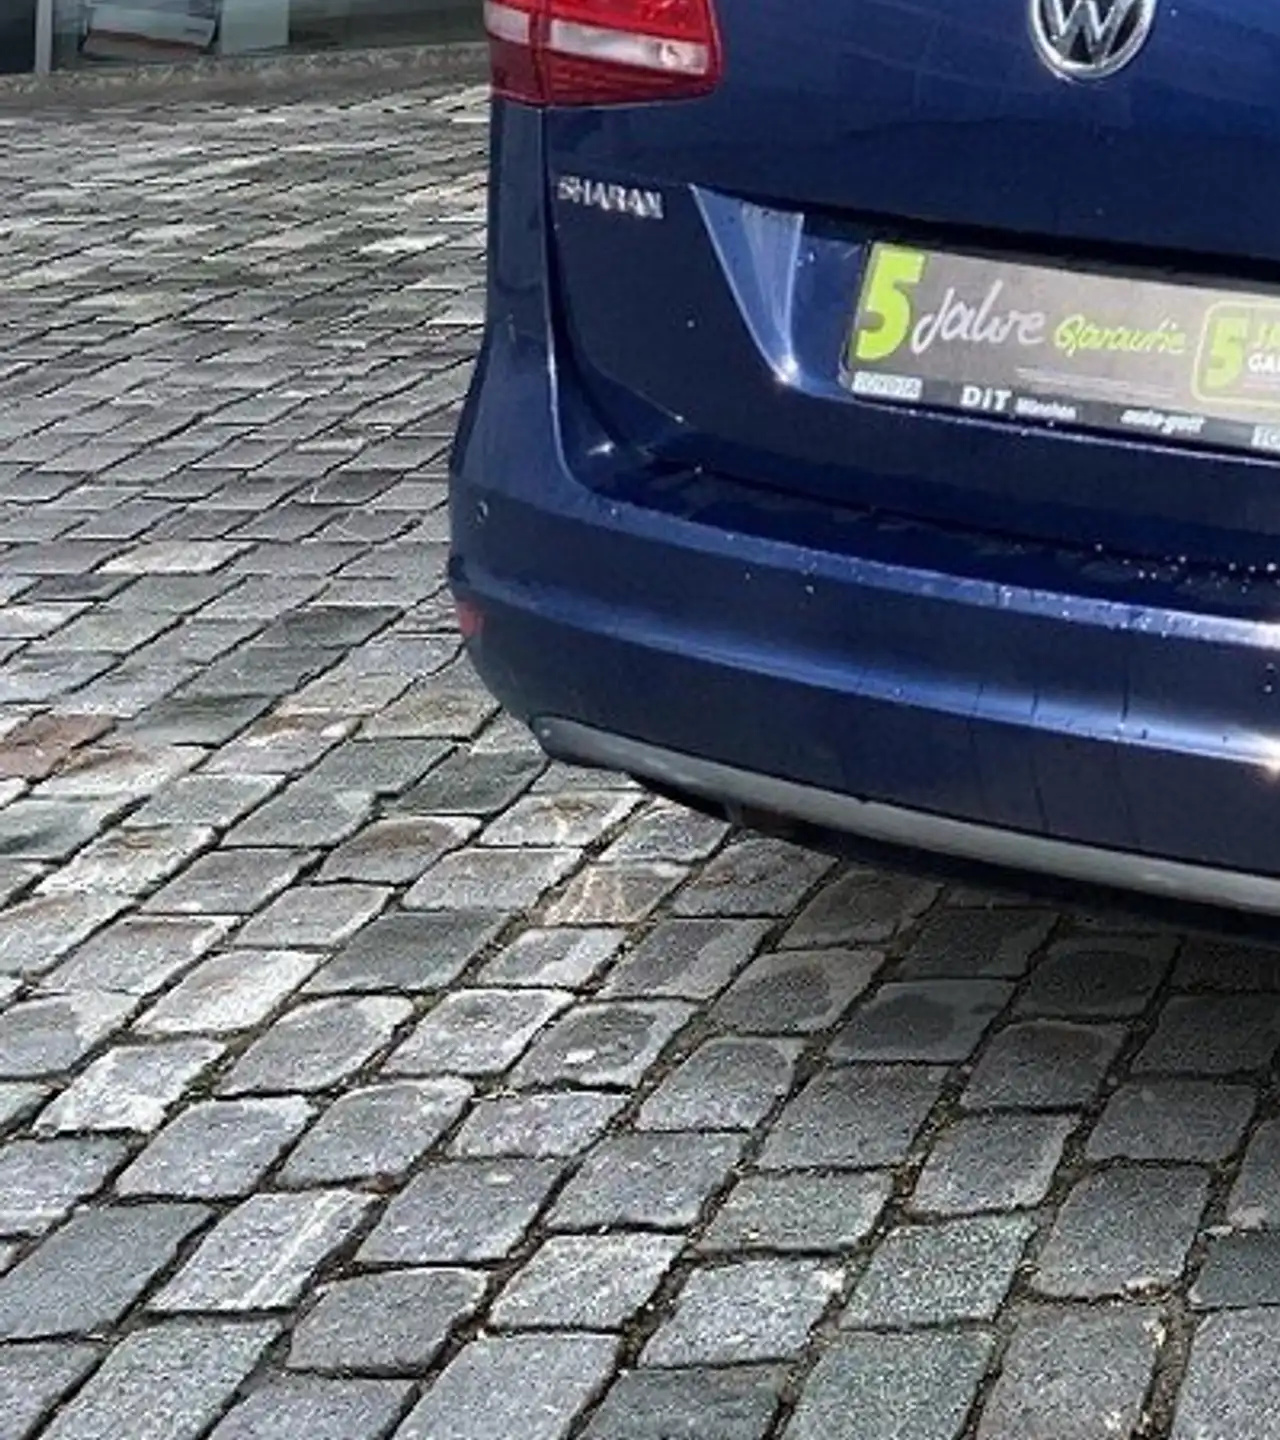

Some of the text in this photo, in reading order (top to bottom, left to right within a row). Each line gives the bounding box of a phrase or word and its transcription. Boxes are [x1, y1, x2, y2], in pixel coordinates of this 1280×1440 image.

[557, 176, 664, 219] SHARAN
[856, 249, 925, 360] 5
[1204, 316, 1249, 388] 5
